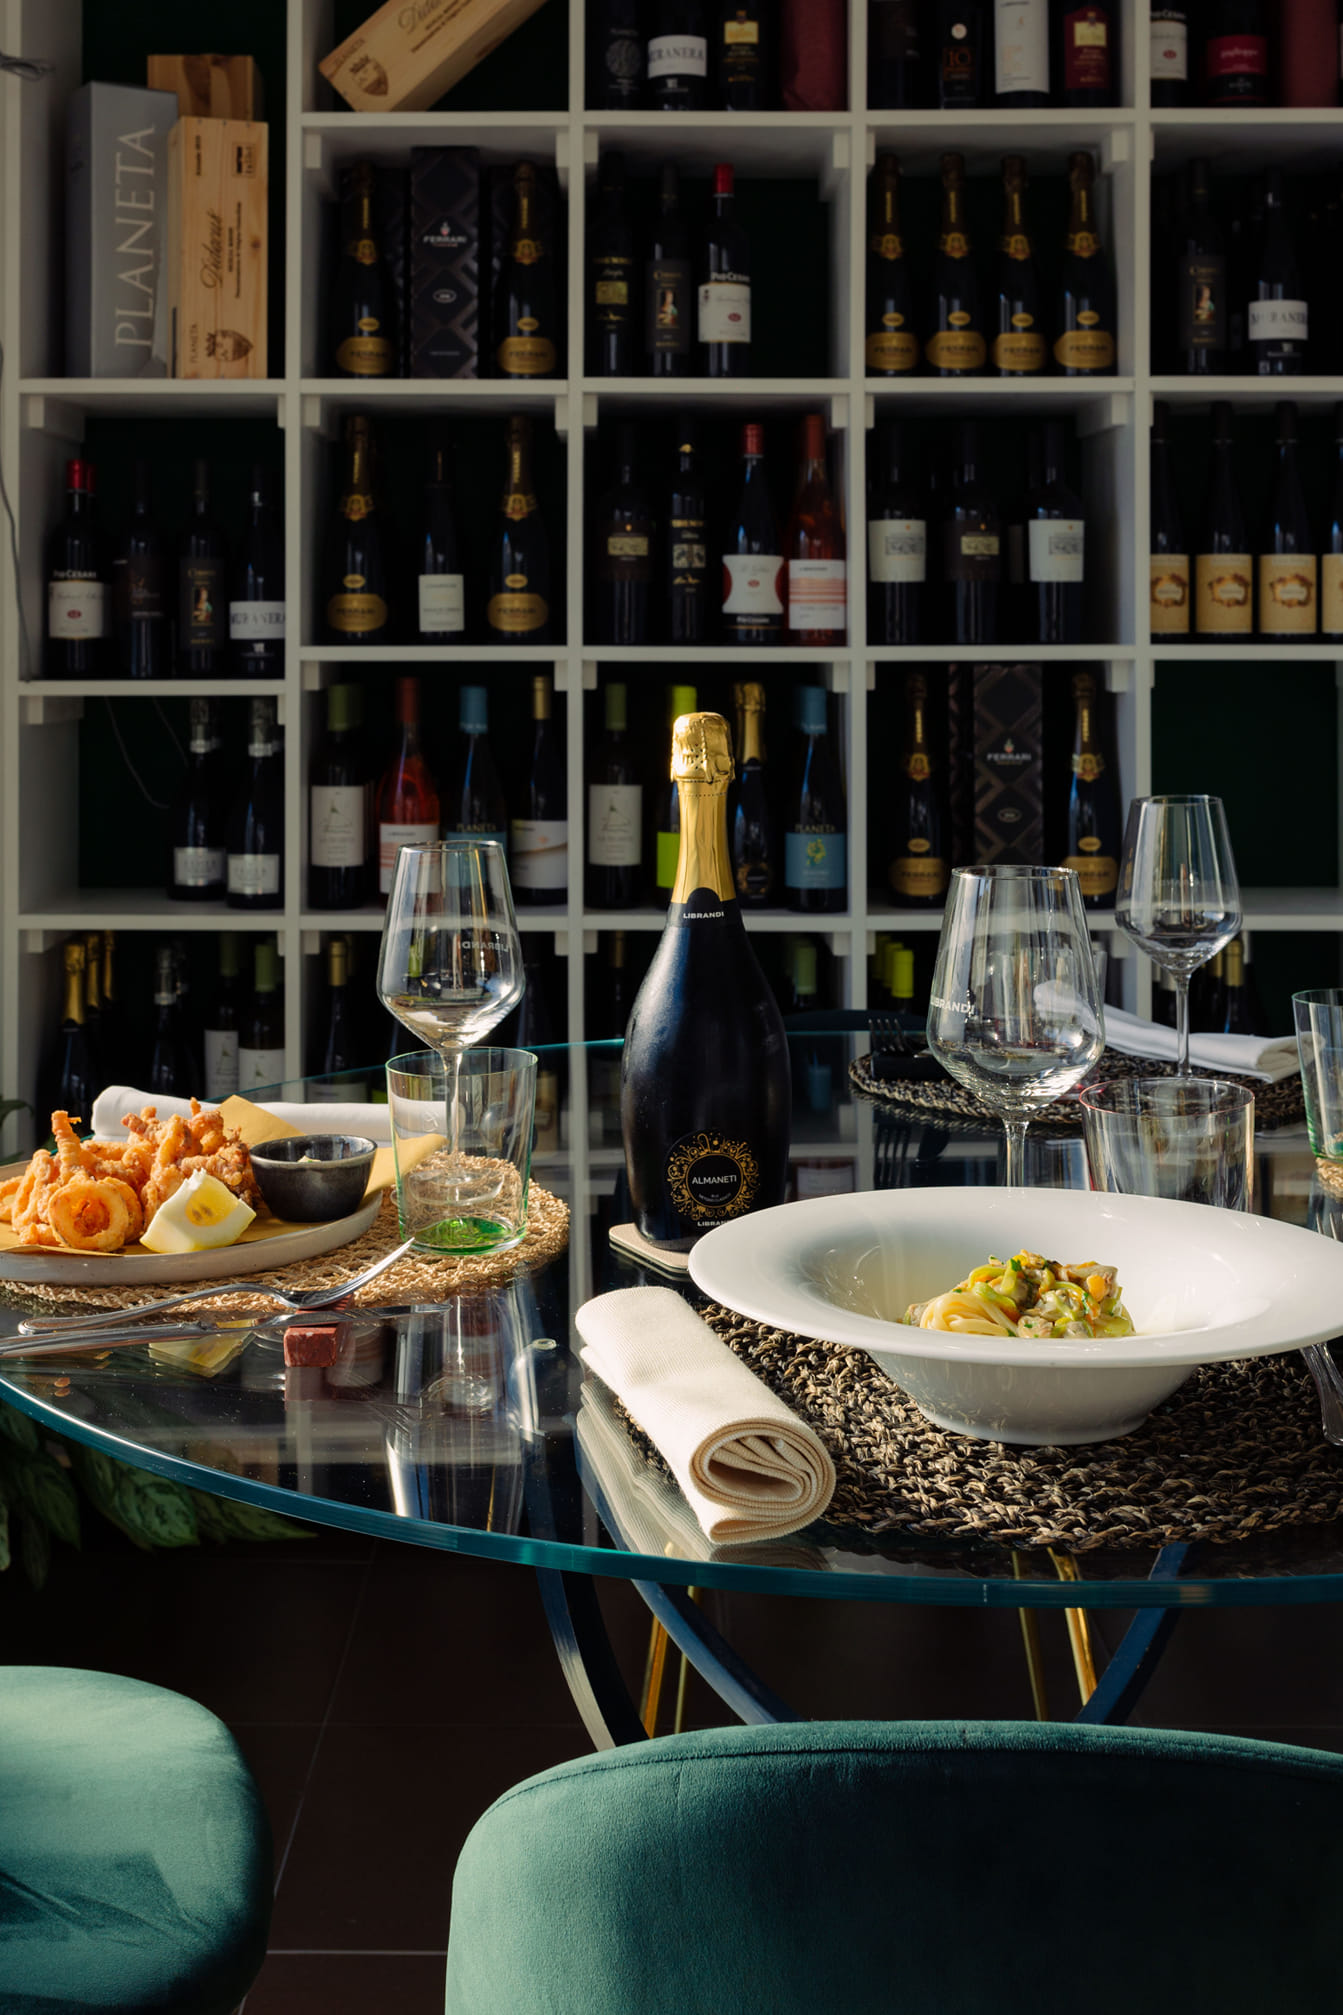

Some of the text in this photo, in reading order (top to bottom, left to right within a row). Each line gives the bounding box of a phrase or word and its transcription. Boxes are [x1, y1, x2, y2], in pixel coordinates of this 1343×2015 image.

[114, 125, 155, 348] PLANETA
[423, 234, 467, 244] FERRARI
[986, 752, 1031, 762] FERRARI
[683, 911, 725, 919] LIBRANDI
[691, 1174, 737, 1185] ALMANETI
